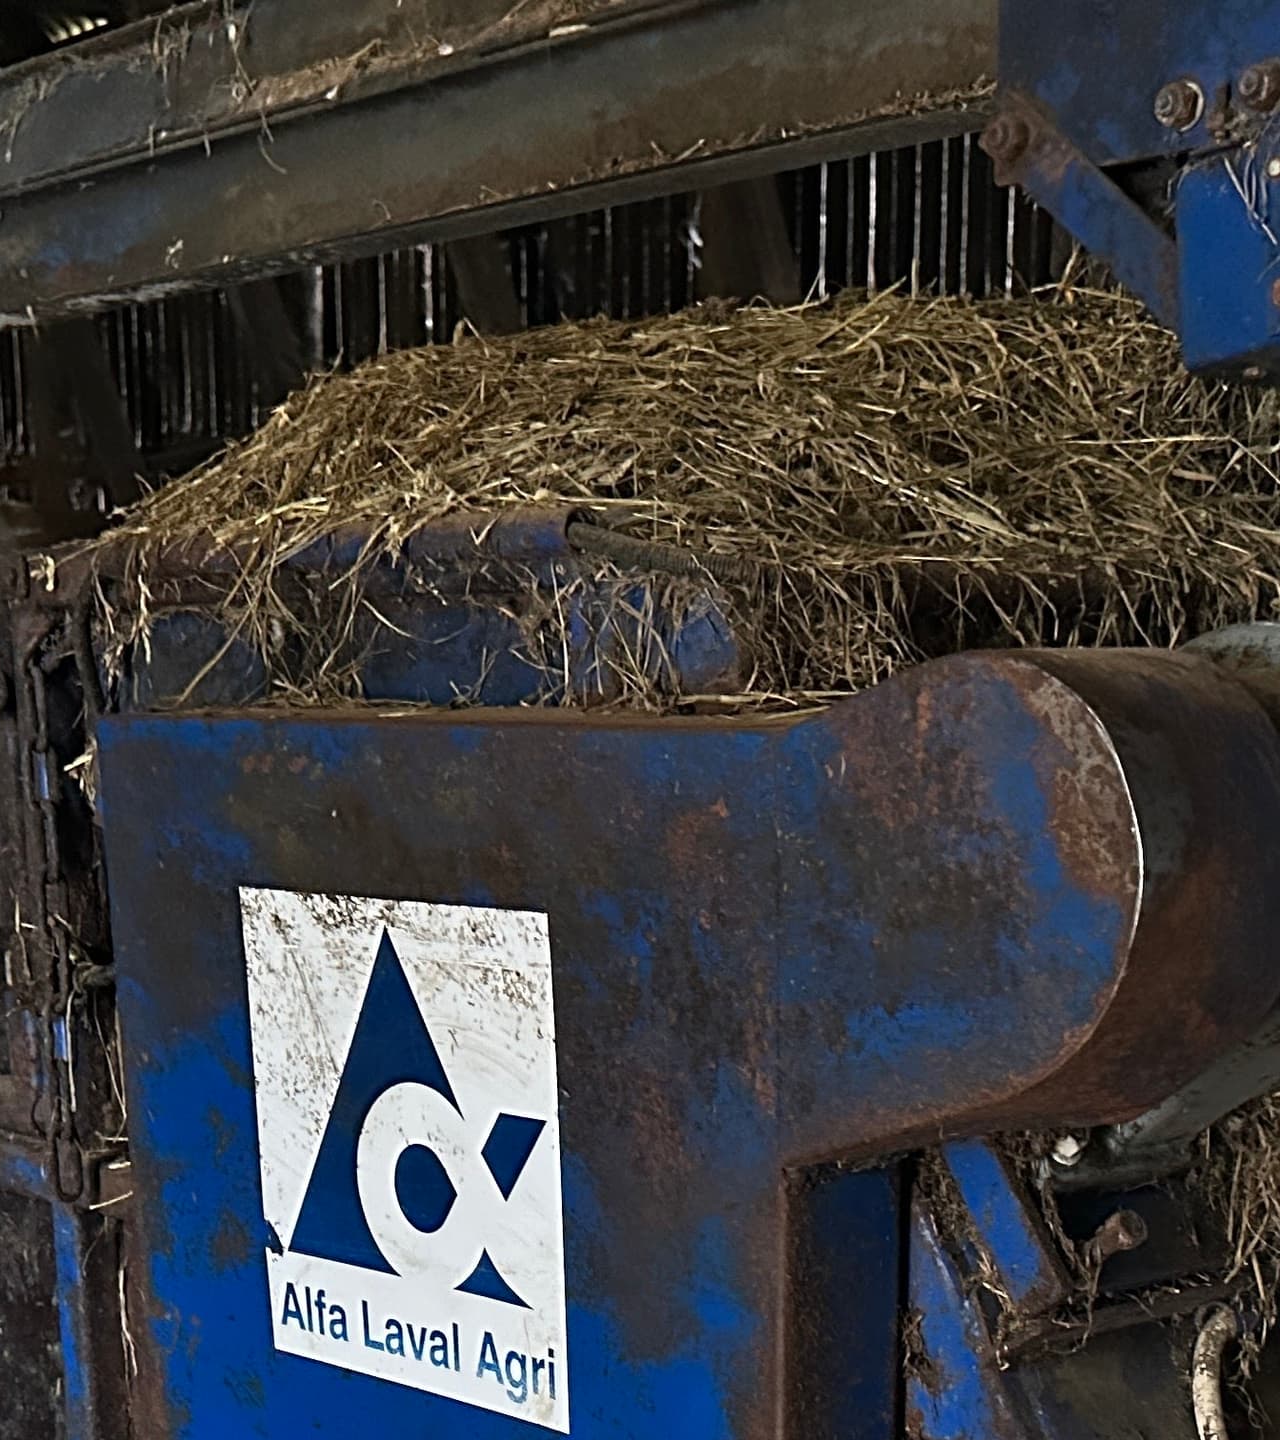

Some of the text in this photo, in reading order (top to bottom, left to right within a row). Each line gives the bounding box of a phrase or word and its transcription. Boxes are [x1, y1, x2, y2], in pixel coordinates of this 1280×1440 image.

[282, 1282, 557, 1403] Alfa Laval Agri
